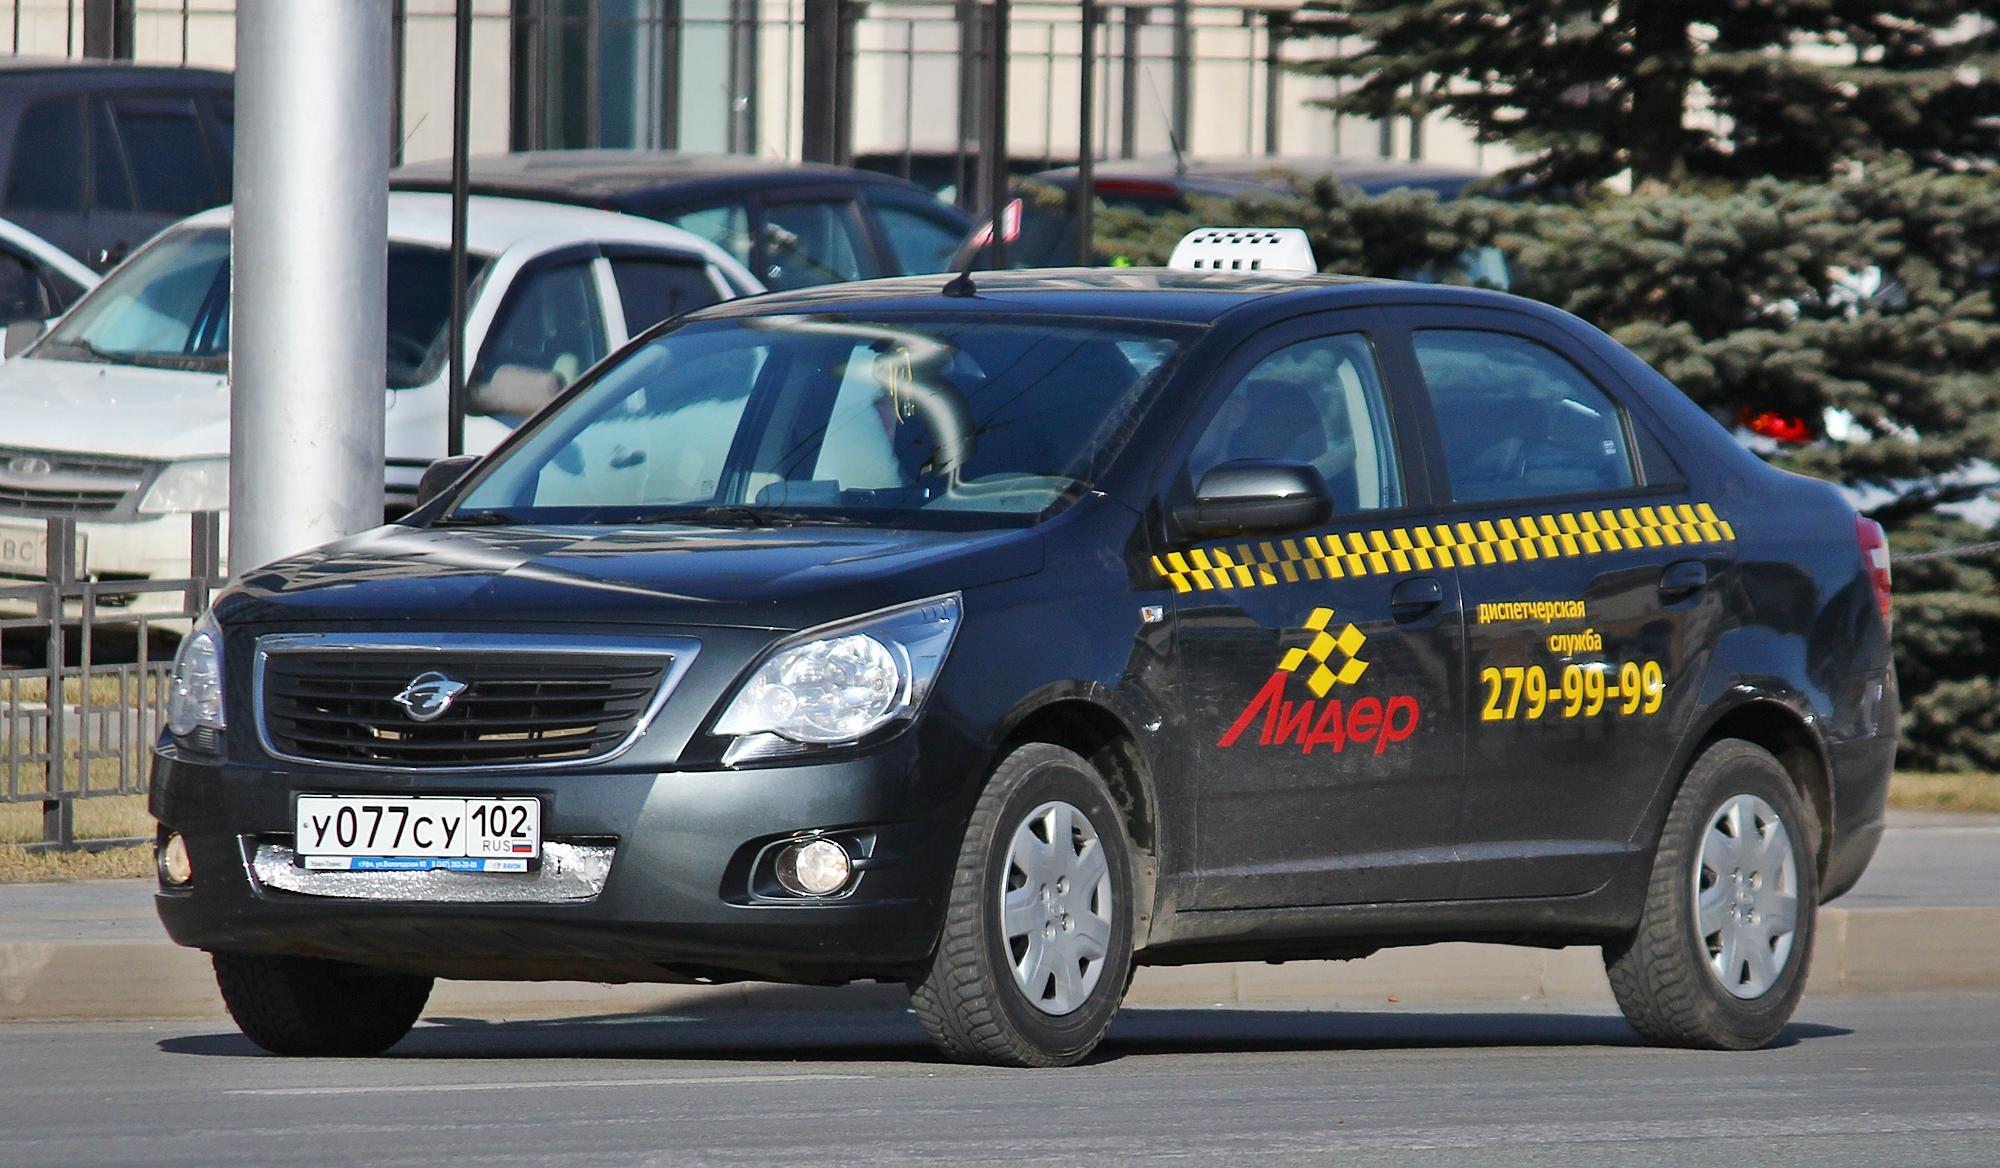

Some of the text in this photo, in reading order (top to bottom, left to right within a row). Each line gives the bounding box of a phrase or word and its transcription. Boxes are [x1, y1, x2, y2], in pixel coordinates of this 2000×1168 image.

[1477, 600, 1585, 624] диспетчерская
[1548, 628, 1602, 656] служба
[1480, 660, 1664, 721] 279-99-99
[1216, 671, 1419, 755] Лидер
[472, 805, 527, 838] 102
[482, 840, 510, 852] RUS
